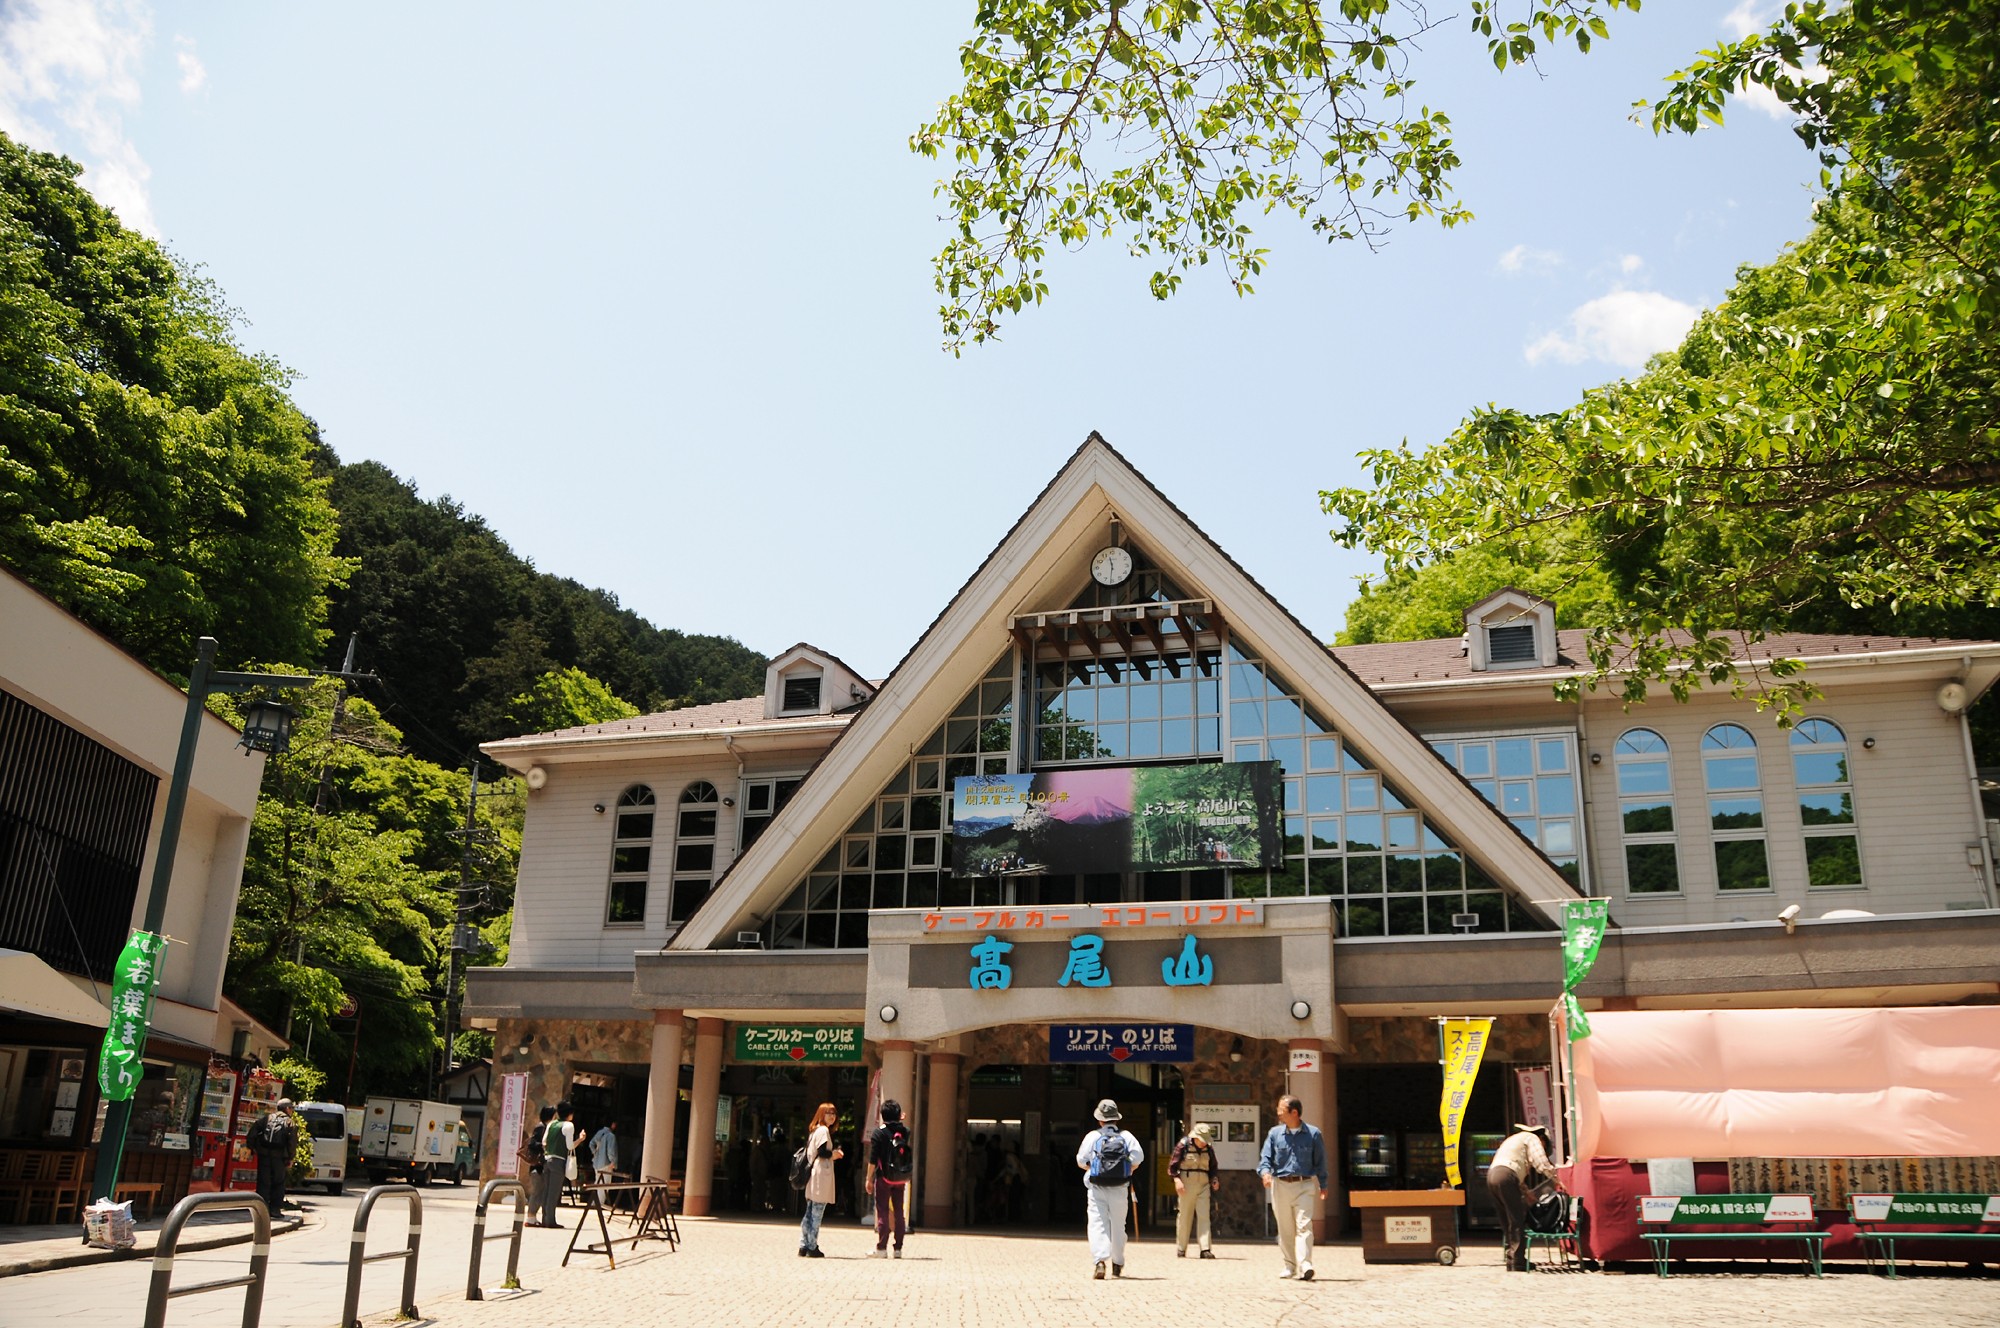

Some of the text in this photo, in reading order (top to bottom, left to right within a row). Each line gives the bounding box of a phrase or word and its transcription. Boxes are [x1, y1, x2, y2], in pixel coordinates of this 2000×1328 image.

[924, 911, 1070, 929] ケーブルカー
[112, 957, 152, 1087] 若葉まつり
[745, 1028, 854, 1043] ケーブルカーのりば
[1068, 1028, 1175, 1044] リフト のりば
[1094, 1043, 1111, 1051] LIFT
[1131, 1043, 1150, 1051] PLAT
[1153, 1043, 1177, 1051] FORM
[1678, 1204, 1722, 1215] 明治の森
[1723, 1203, 1766, 1214] 国定公園
[1892, 1203, 1937, 1213] 明治の森
[1938, 1202, 1983, 1214] 国定公園
